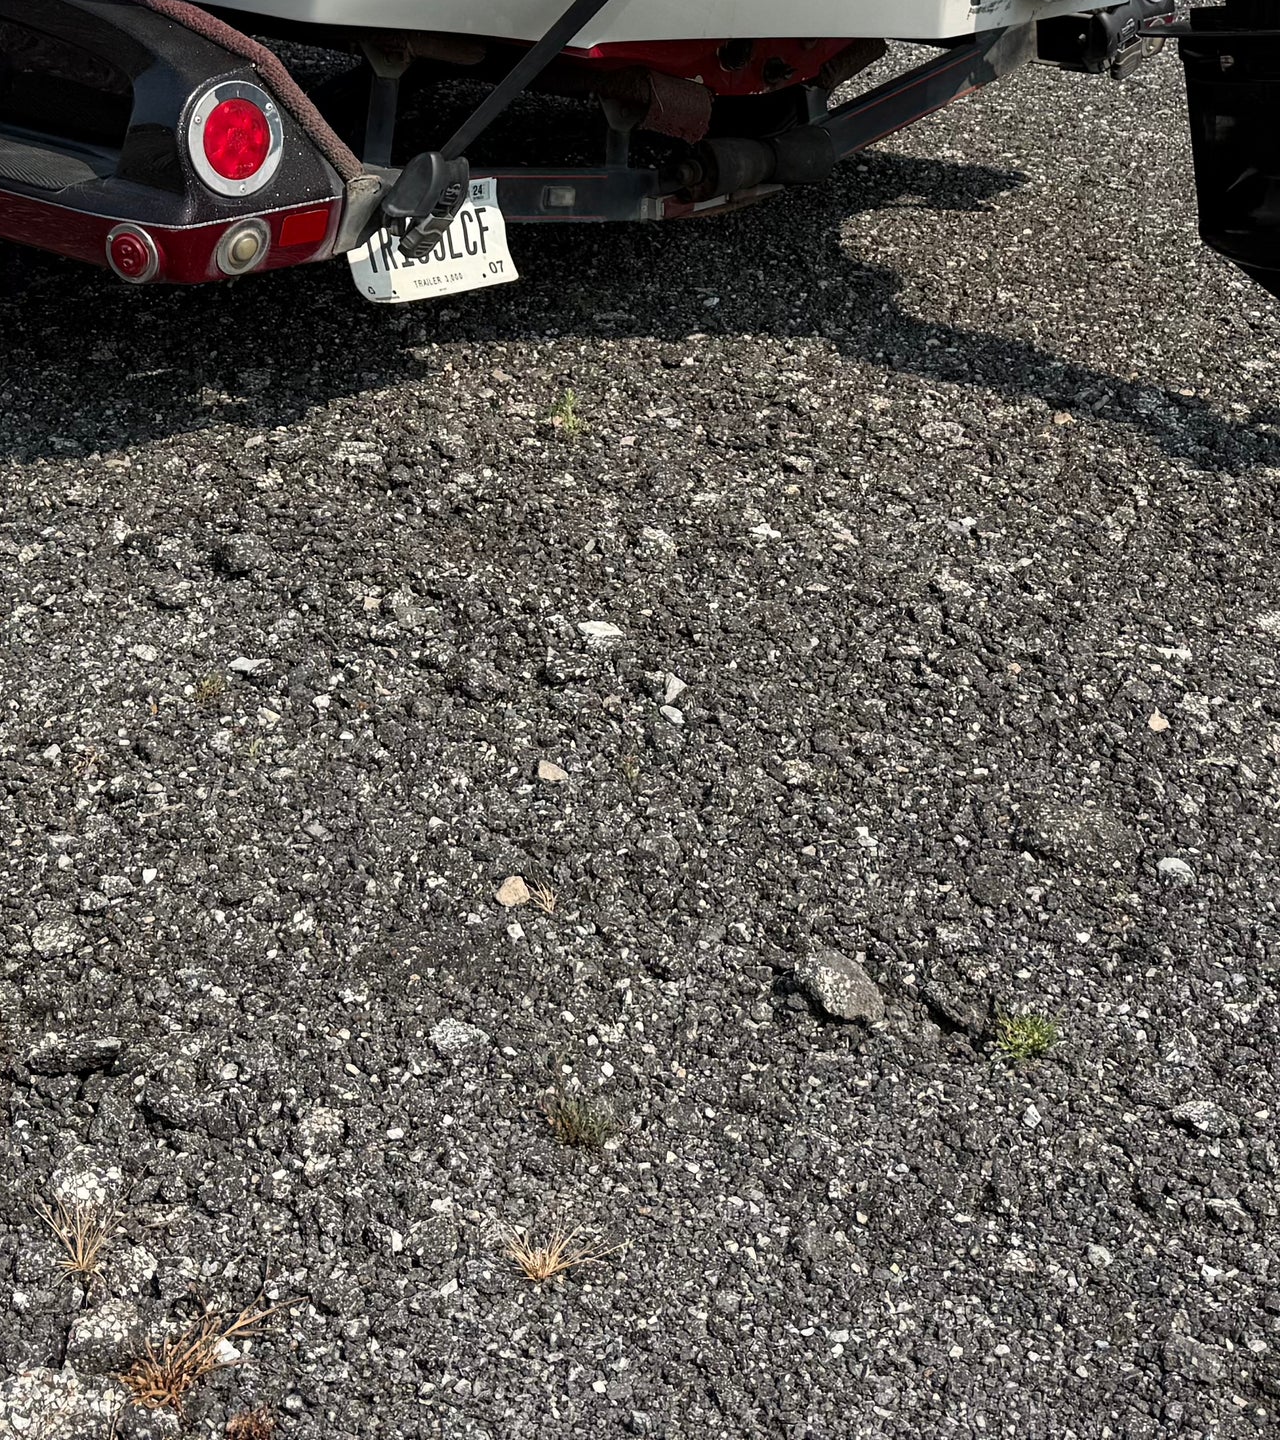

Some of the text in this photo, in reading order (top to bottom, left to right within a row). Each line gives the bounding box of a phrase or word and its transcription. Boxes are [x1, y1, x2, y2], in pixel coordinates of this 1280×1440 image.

[472, 184, 484, 197] 24
[488, 260, 505, 274] 07
[412, 277, 443, 289] TRAILER
